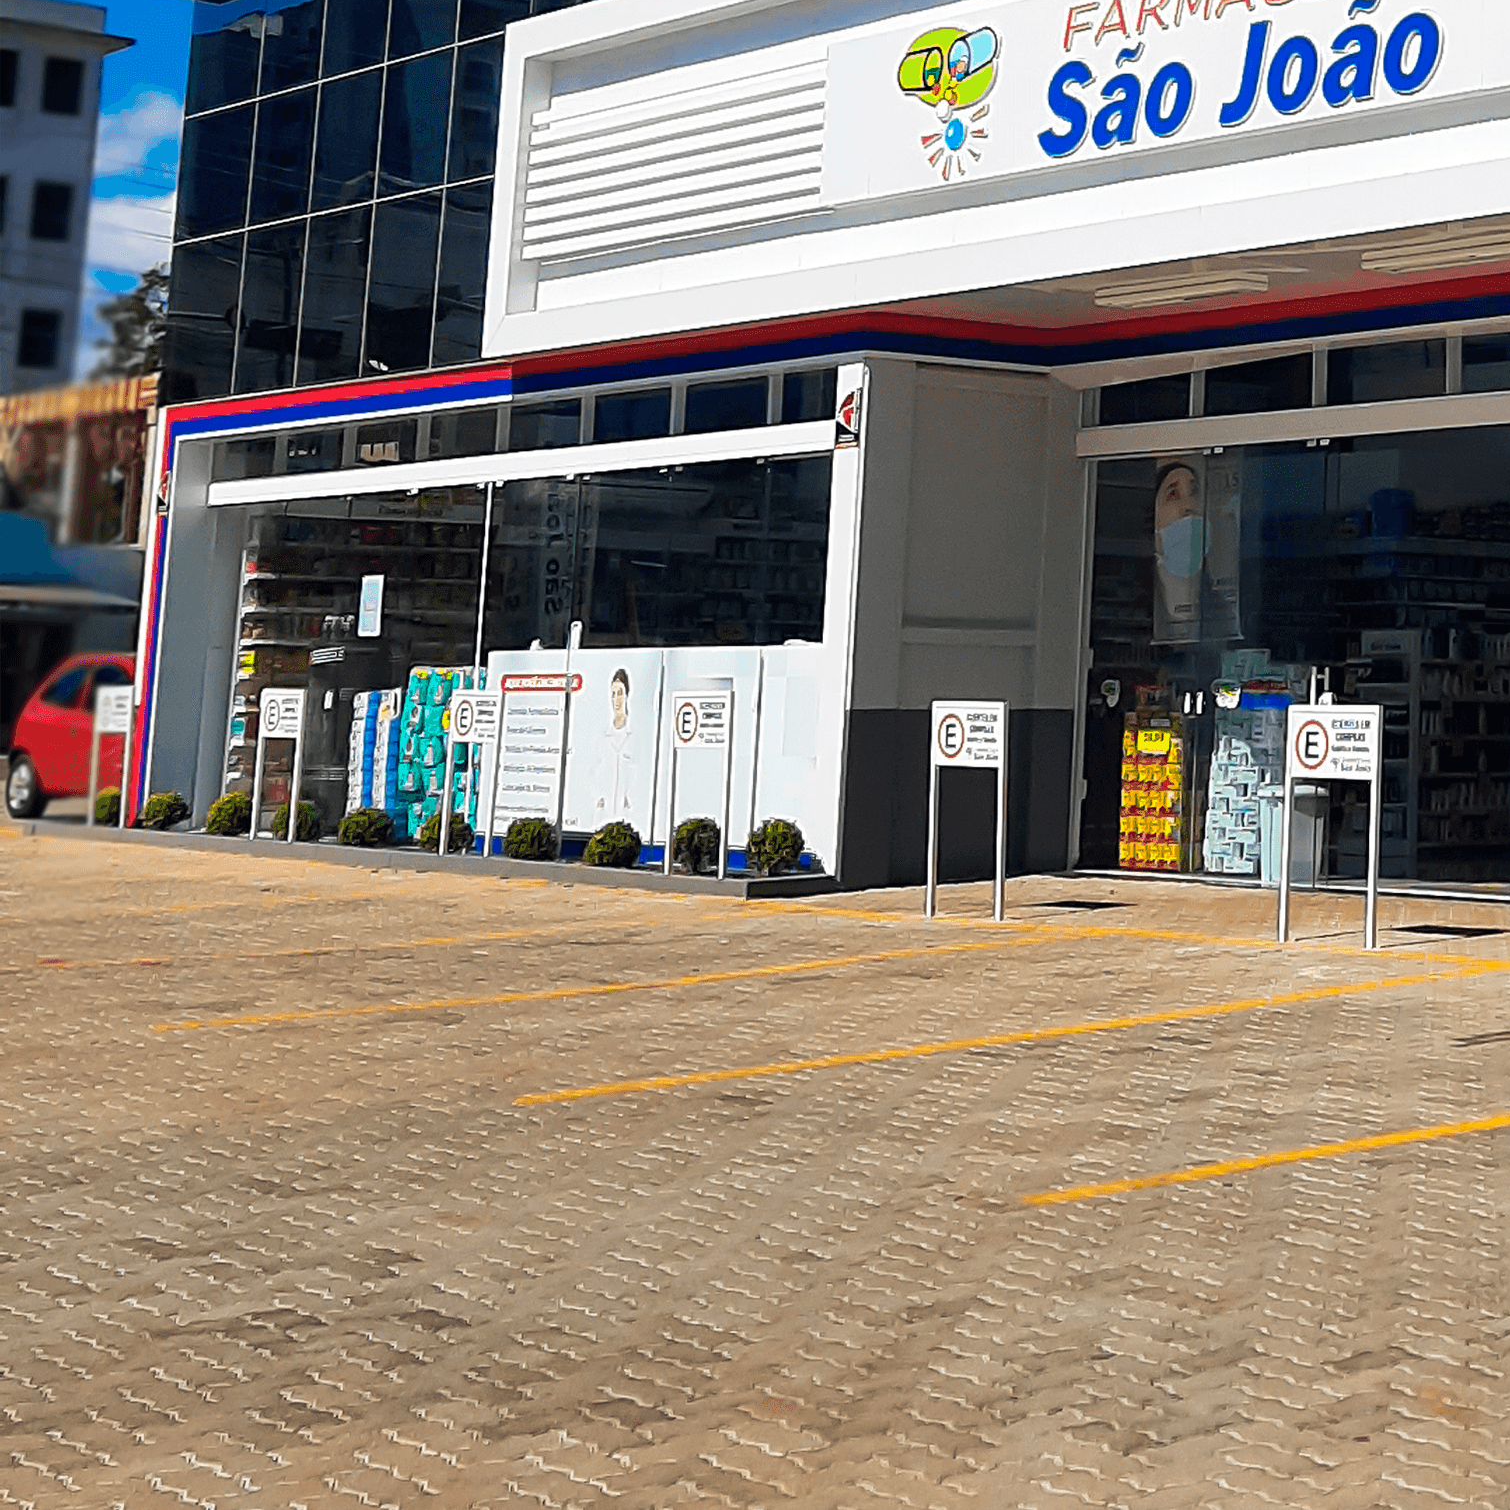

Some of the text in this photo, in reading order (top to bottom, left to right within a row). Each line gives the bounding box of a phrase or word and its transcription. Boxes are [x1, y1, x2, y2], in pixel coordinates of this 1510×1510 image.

[1037, 42, 1196, 158] São
[681, 711, 692, 734] E
[945, 723, 957, 749] E
[1305, 731, 1320, 759] E
